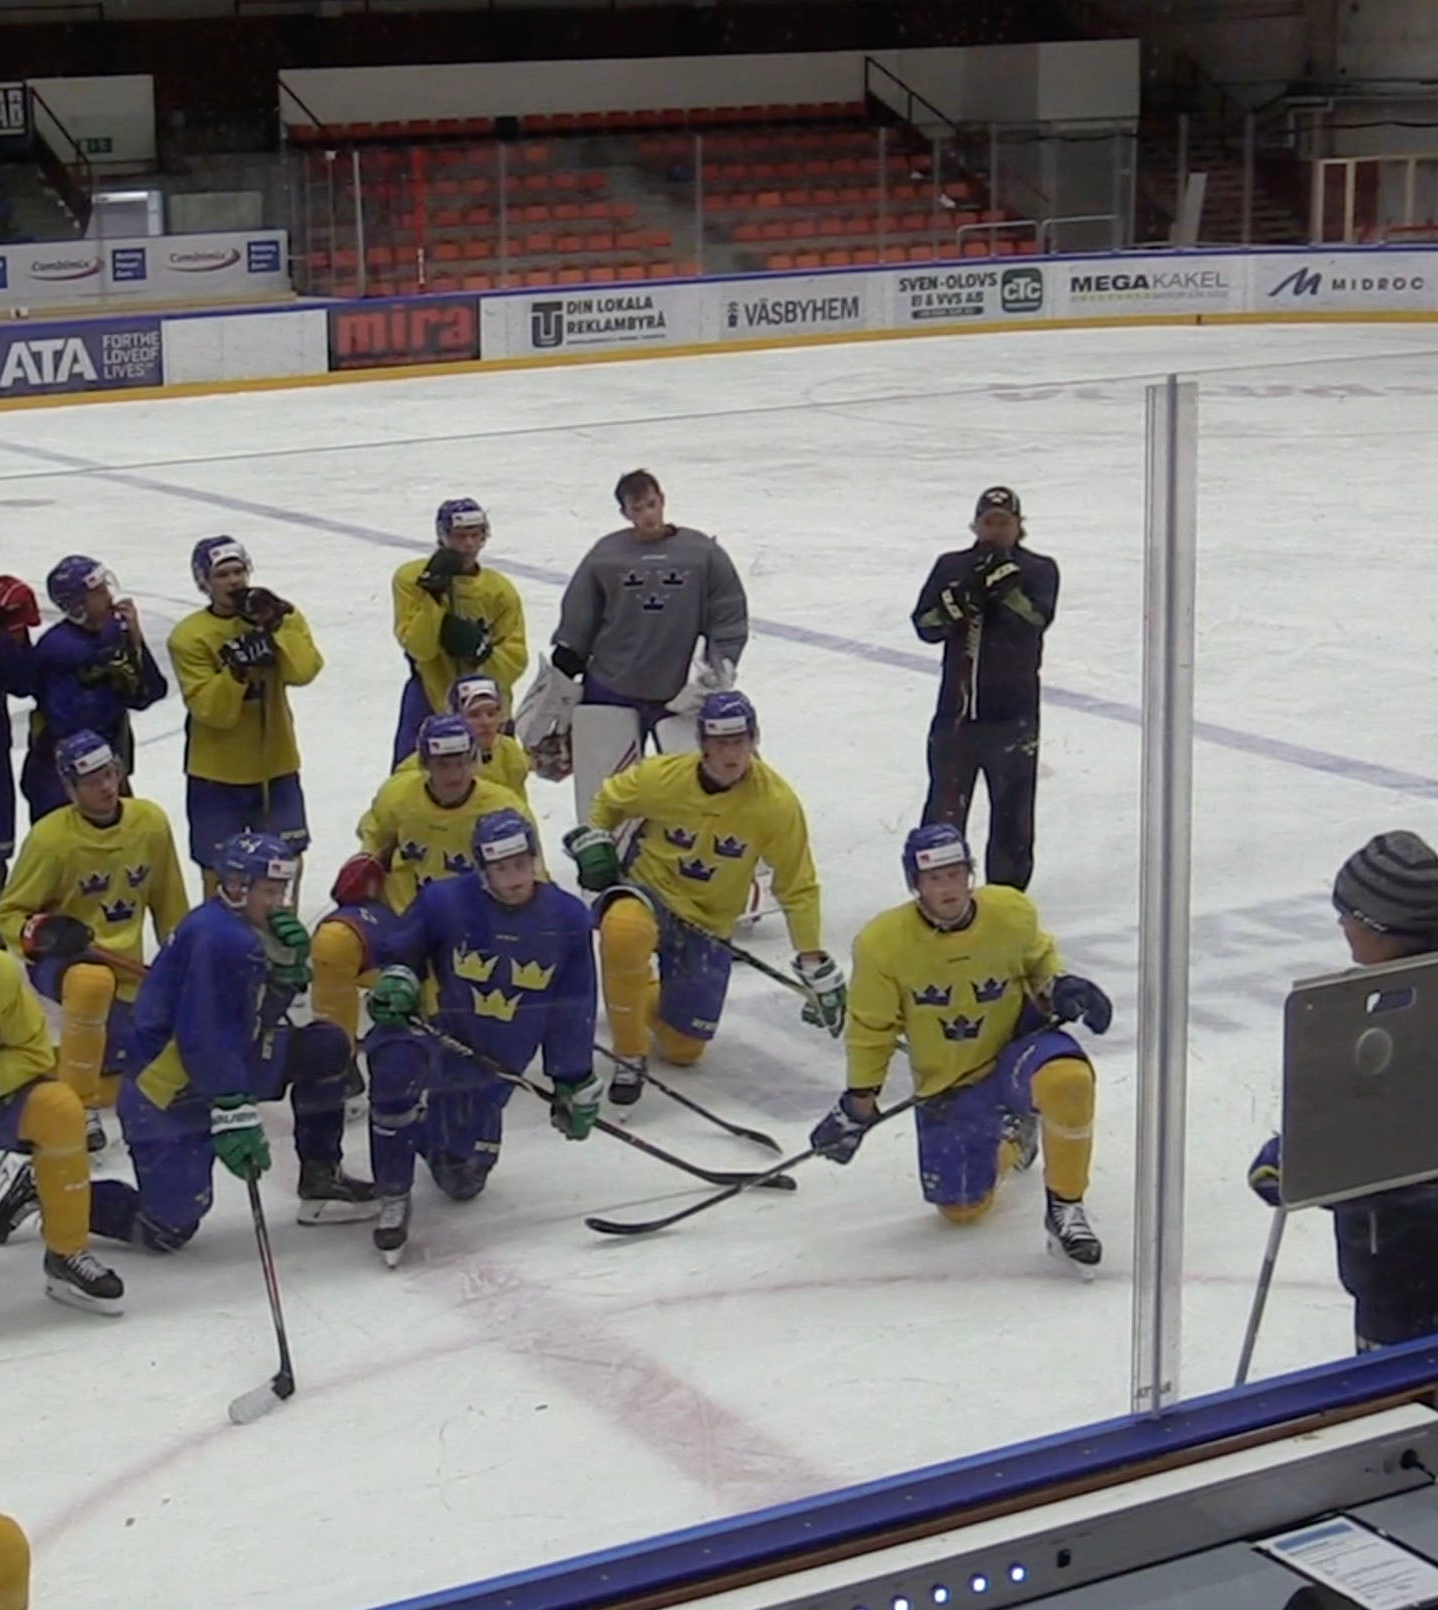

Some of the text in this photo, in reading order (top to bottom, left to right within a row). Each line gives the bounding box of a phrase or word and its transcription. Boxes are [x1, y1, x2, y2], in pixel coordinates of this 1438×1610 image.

[1003, 277, 1041, 300] CTC
[1332, 276, 1425, 291] MIDROC
[566, 296, 653, 315] DIN LOKALA
[745, 295, 860, 327] VÄSBYHEM
[337, 304, 471, 352] mira
[566, 310, 667, 335] REKLAMBYRÅ
[103, 362, 146, 380] LIVES
